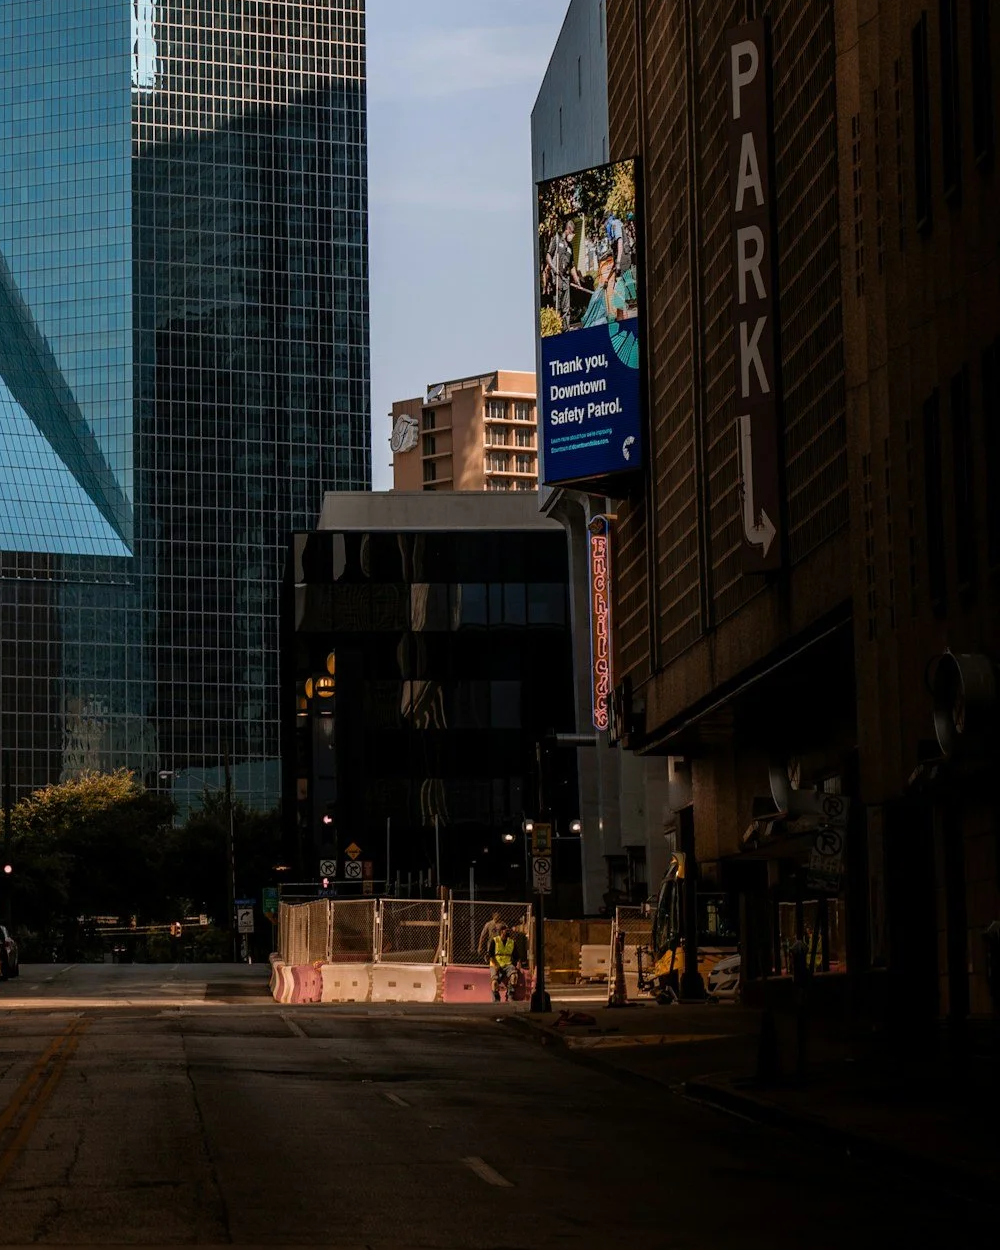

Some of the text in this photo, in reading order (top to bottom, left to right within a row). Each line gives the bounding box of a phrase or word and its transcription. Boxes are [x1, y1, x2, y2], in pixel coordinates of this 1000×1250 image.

[730, 40, 770, 398] PARK
[549, 353, 608, 376] Thank you,
[550, 378, 606, 401] Downtown
[551, 397, 622, 426] Safety Patrol.
